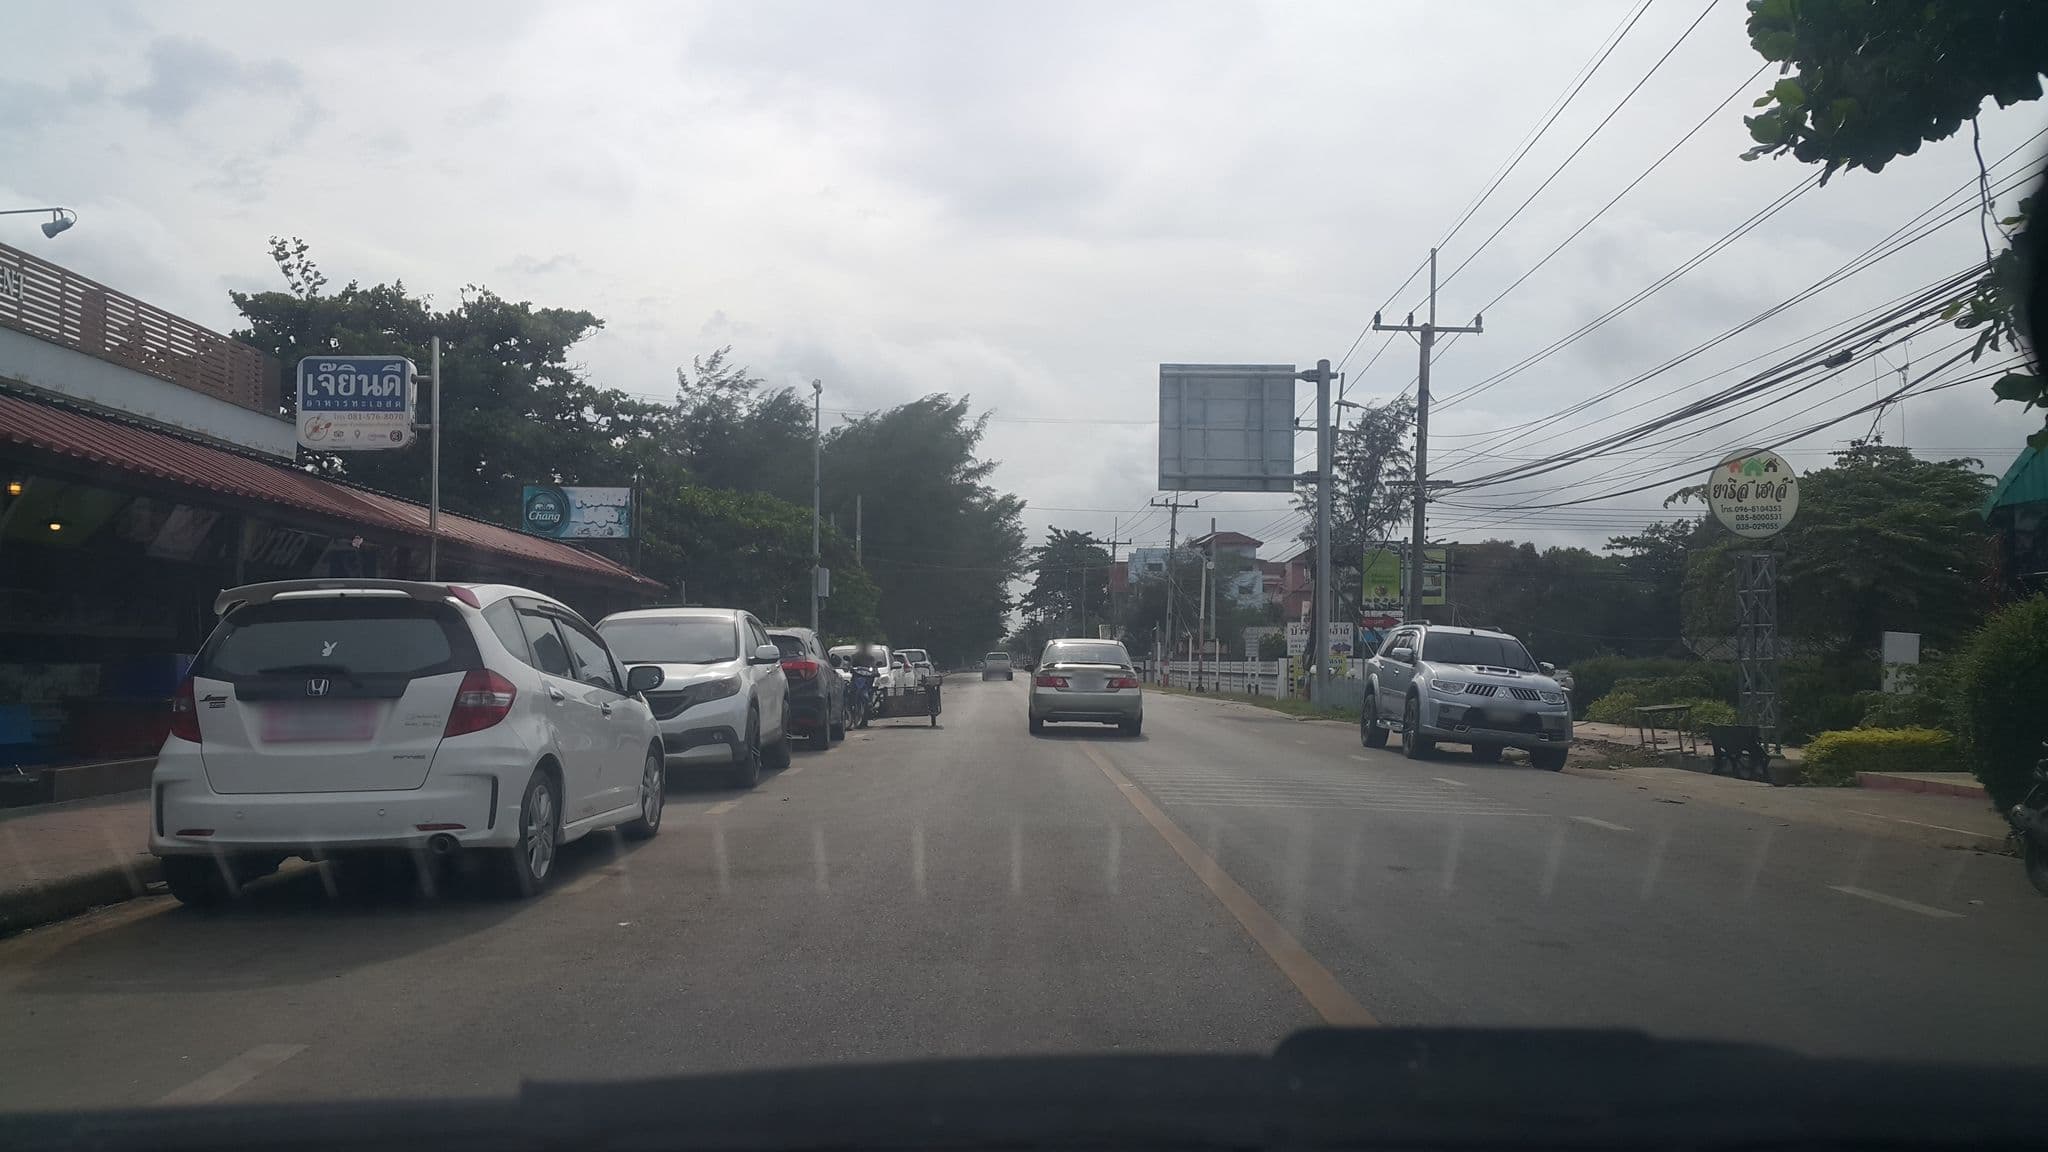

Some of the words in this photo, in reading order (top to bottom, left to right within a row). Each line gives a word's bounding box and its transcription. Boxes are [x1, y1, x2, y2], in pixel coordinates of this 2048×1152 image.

[306, 362, 401, 396] เจ๊ยินดี
[528, 510, 561, 522] Chang
